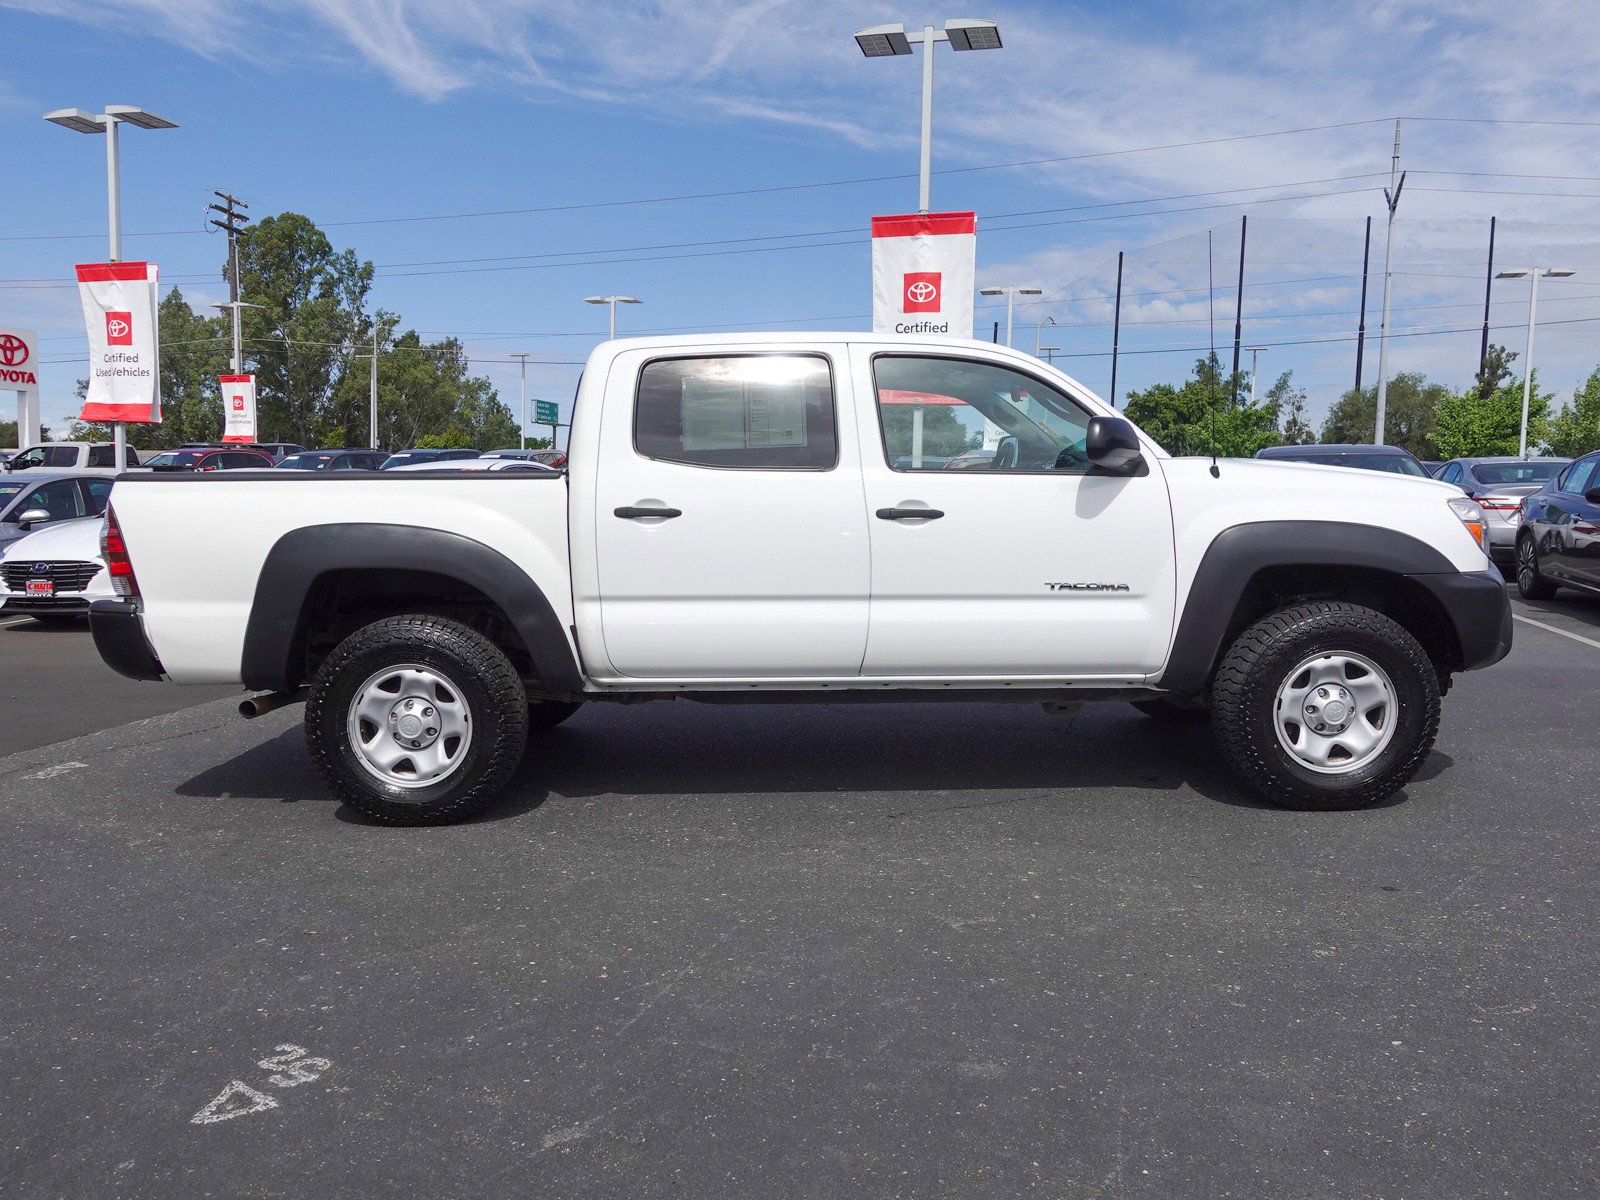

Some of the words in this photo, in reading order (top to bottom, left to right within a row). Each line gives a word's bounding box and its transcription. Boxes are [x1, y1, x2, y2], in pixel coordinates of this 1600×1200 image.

[895, 321, 948, 334] Certified
[103, 353, 139, 363] Cetified
[0, 369, 37, 384] YOTA
[112, 367, 150, 377] Vehicles
[1044, 582, 1130, 592] TACOMA
